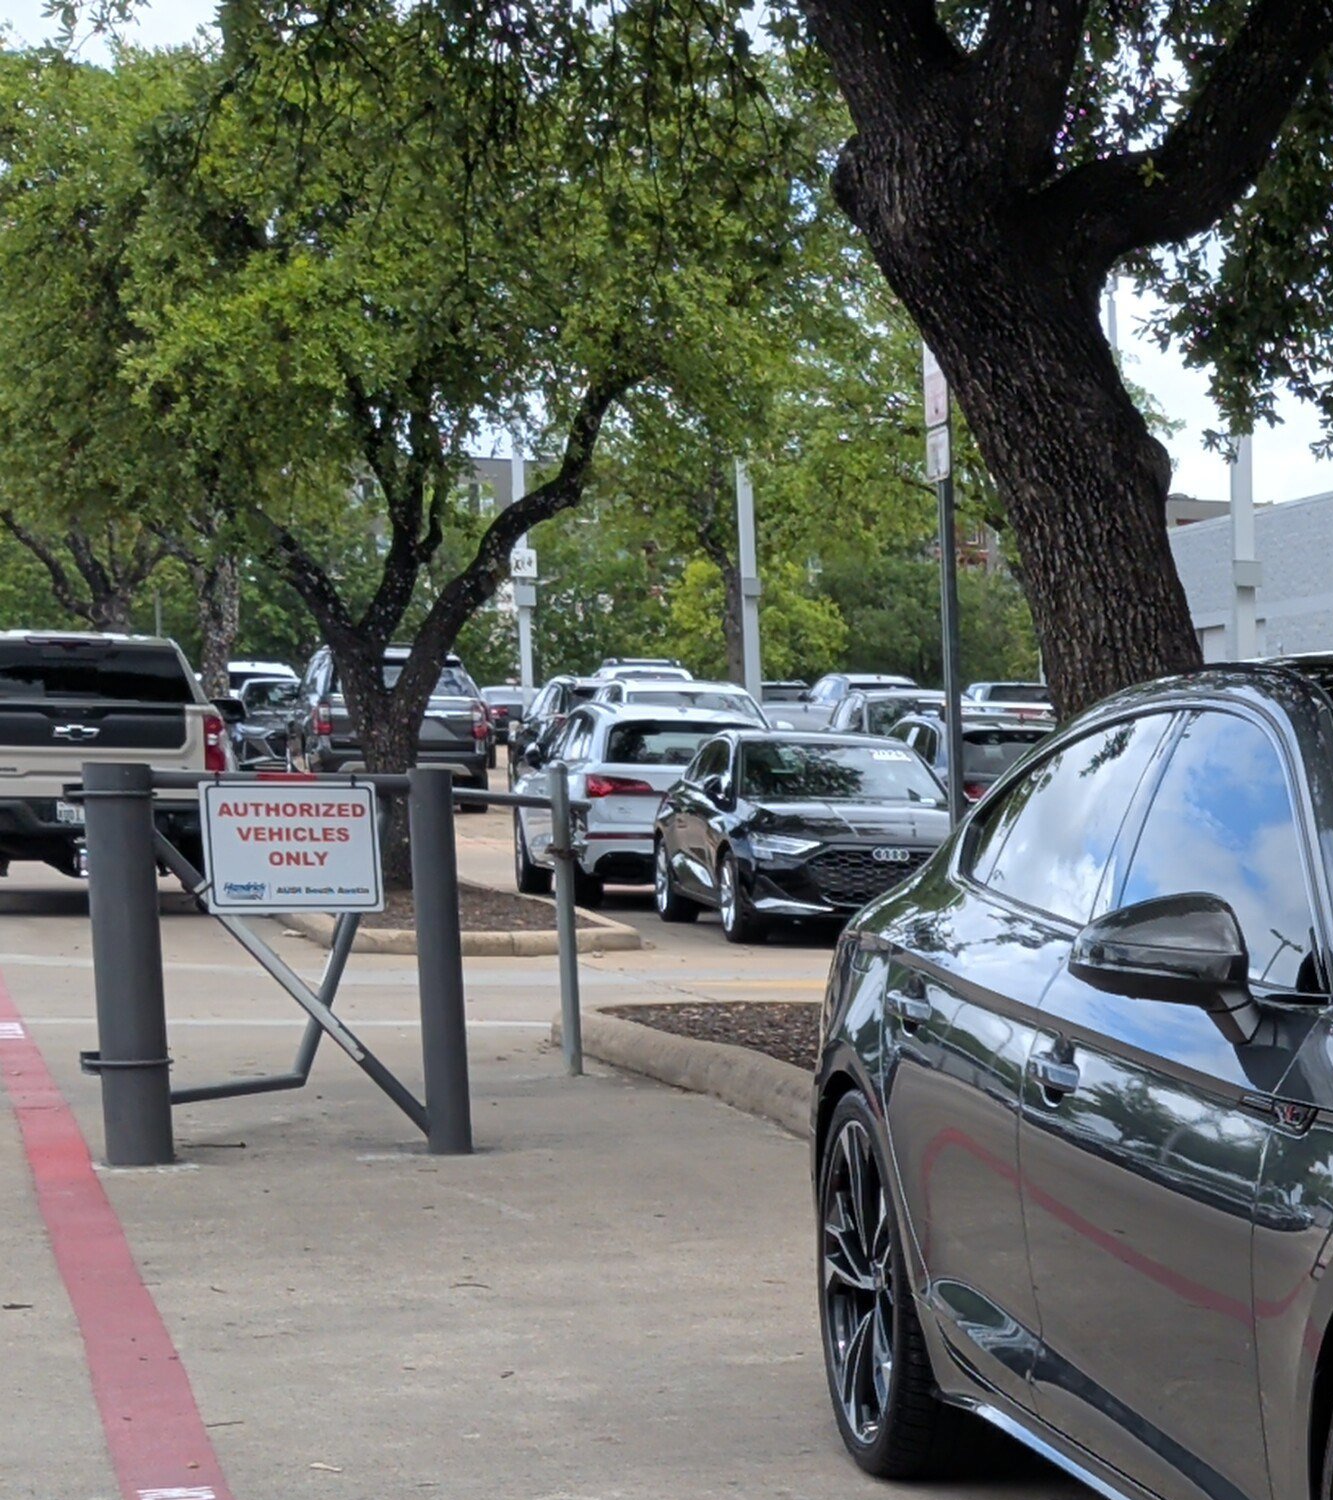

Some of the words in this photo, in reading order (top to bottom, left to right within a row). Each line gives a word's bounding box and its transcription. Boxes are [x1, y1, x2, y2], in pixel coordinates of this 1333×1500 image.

[218, 802, 366, 818] AUTHORIZED
[237, 827, 350, 842] VEHICLES
[269, 851, 328, 866] ONLY
